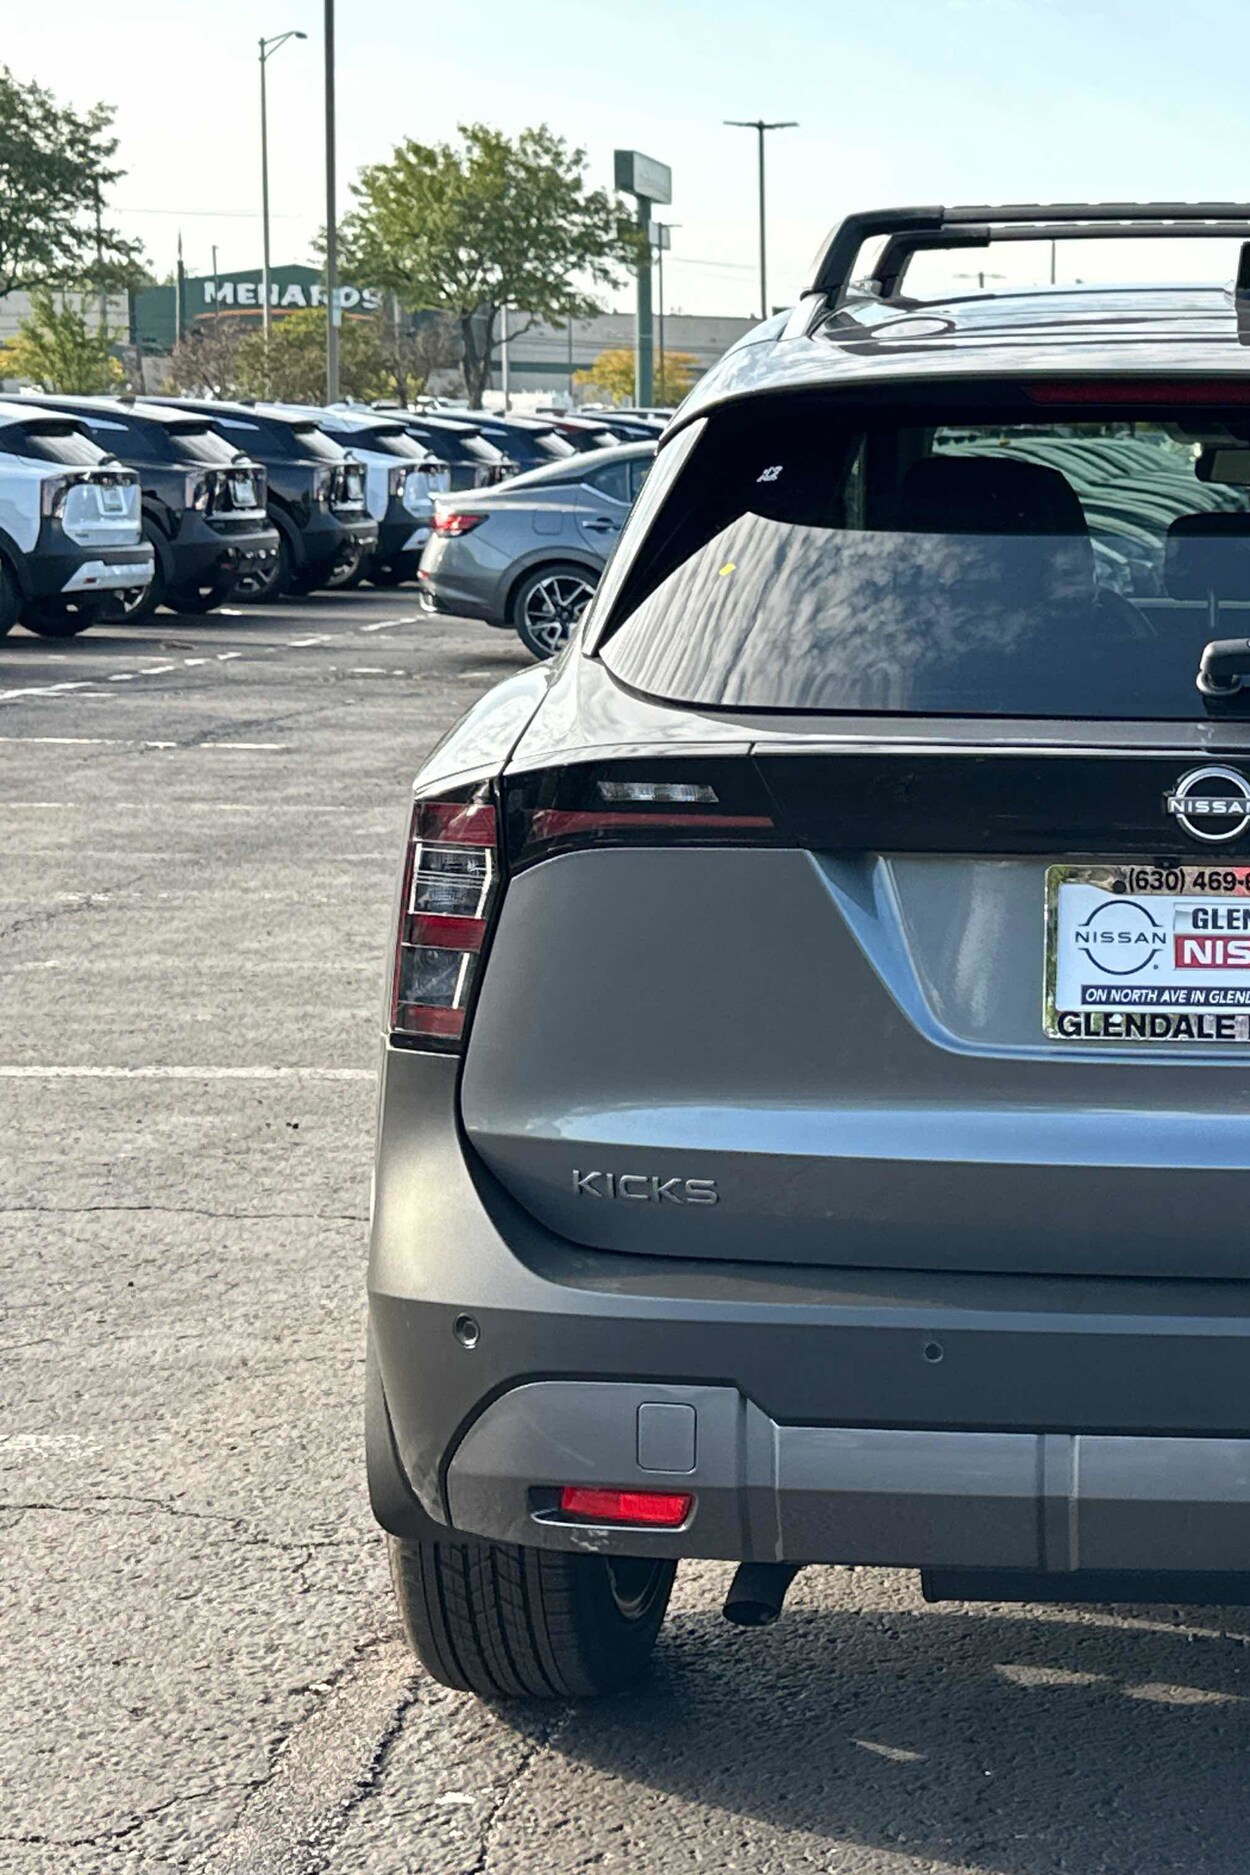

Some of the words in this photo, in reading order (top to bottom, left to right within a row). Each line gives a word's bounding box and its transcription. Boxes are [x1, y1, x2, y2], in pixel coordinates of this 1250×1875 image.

[1129, 868, 1185, 893] (630)
[1075, 931, 1167, 945] NISSAN
[1085, 988, 1107, 1002] ON
[1110, 989, 1158, 1003] NORTH
[1160, 990, 1188, 1003] AVE
[1190, 990, 1206, 1003] IN
[1057, 1012, 1236, 1039] GLENDALE
[572, 1169, 720, 1205] KICKS
